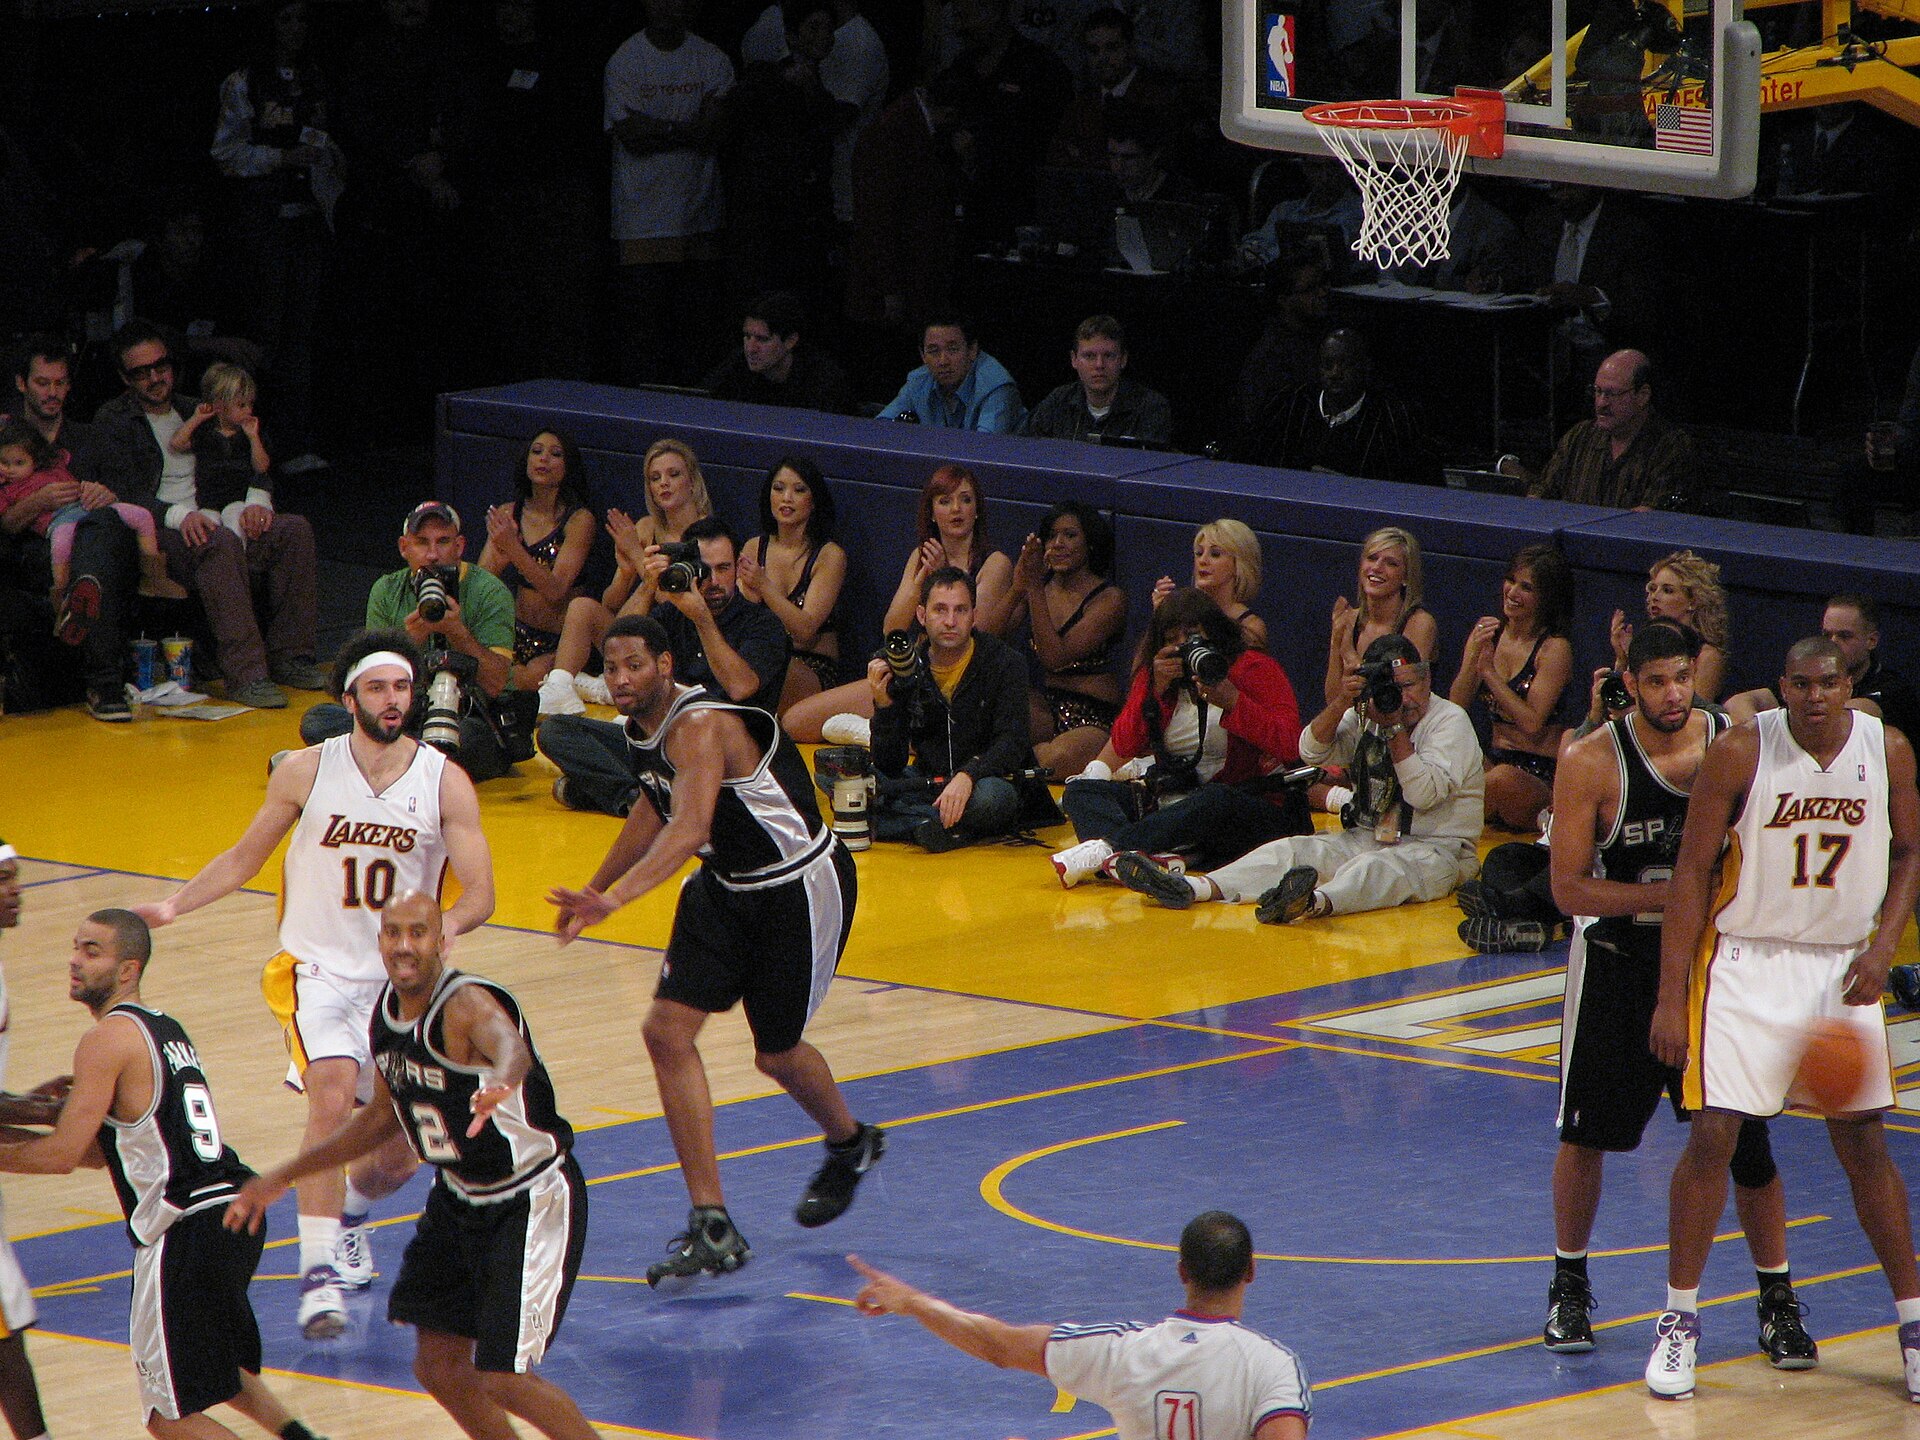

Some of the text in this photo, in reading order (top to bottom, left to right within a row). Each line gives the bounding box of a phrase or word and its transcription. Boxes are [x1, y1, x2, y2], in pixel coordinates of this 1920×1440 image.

[1269, 80, 1286, 92] NBA
[1760, 78, 1804, 105] nter
[1763, 792, 1868, 829] LAKERS
[319, 814, 418, 853] LAKERS
[1791, 832, 1852, 890] 17
[342, 856, 397, 912] 10
[182, 1083, 222, 1163] 9
[1163, 1397, 1197, 1440] 71
